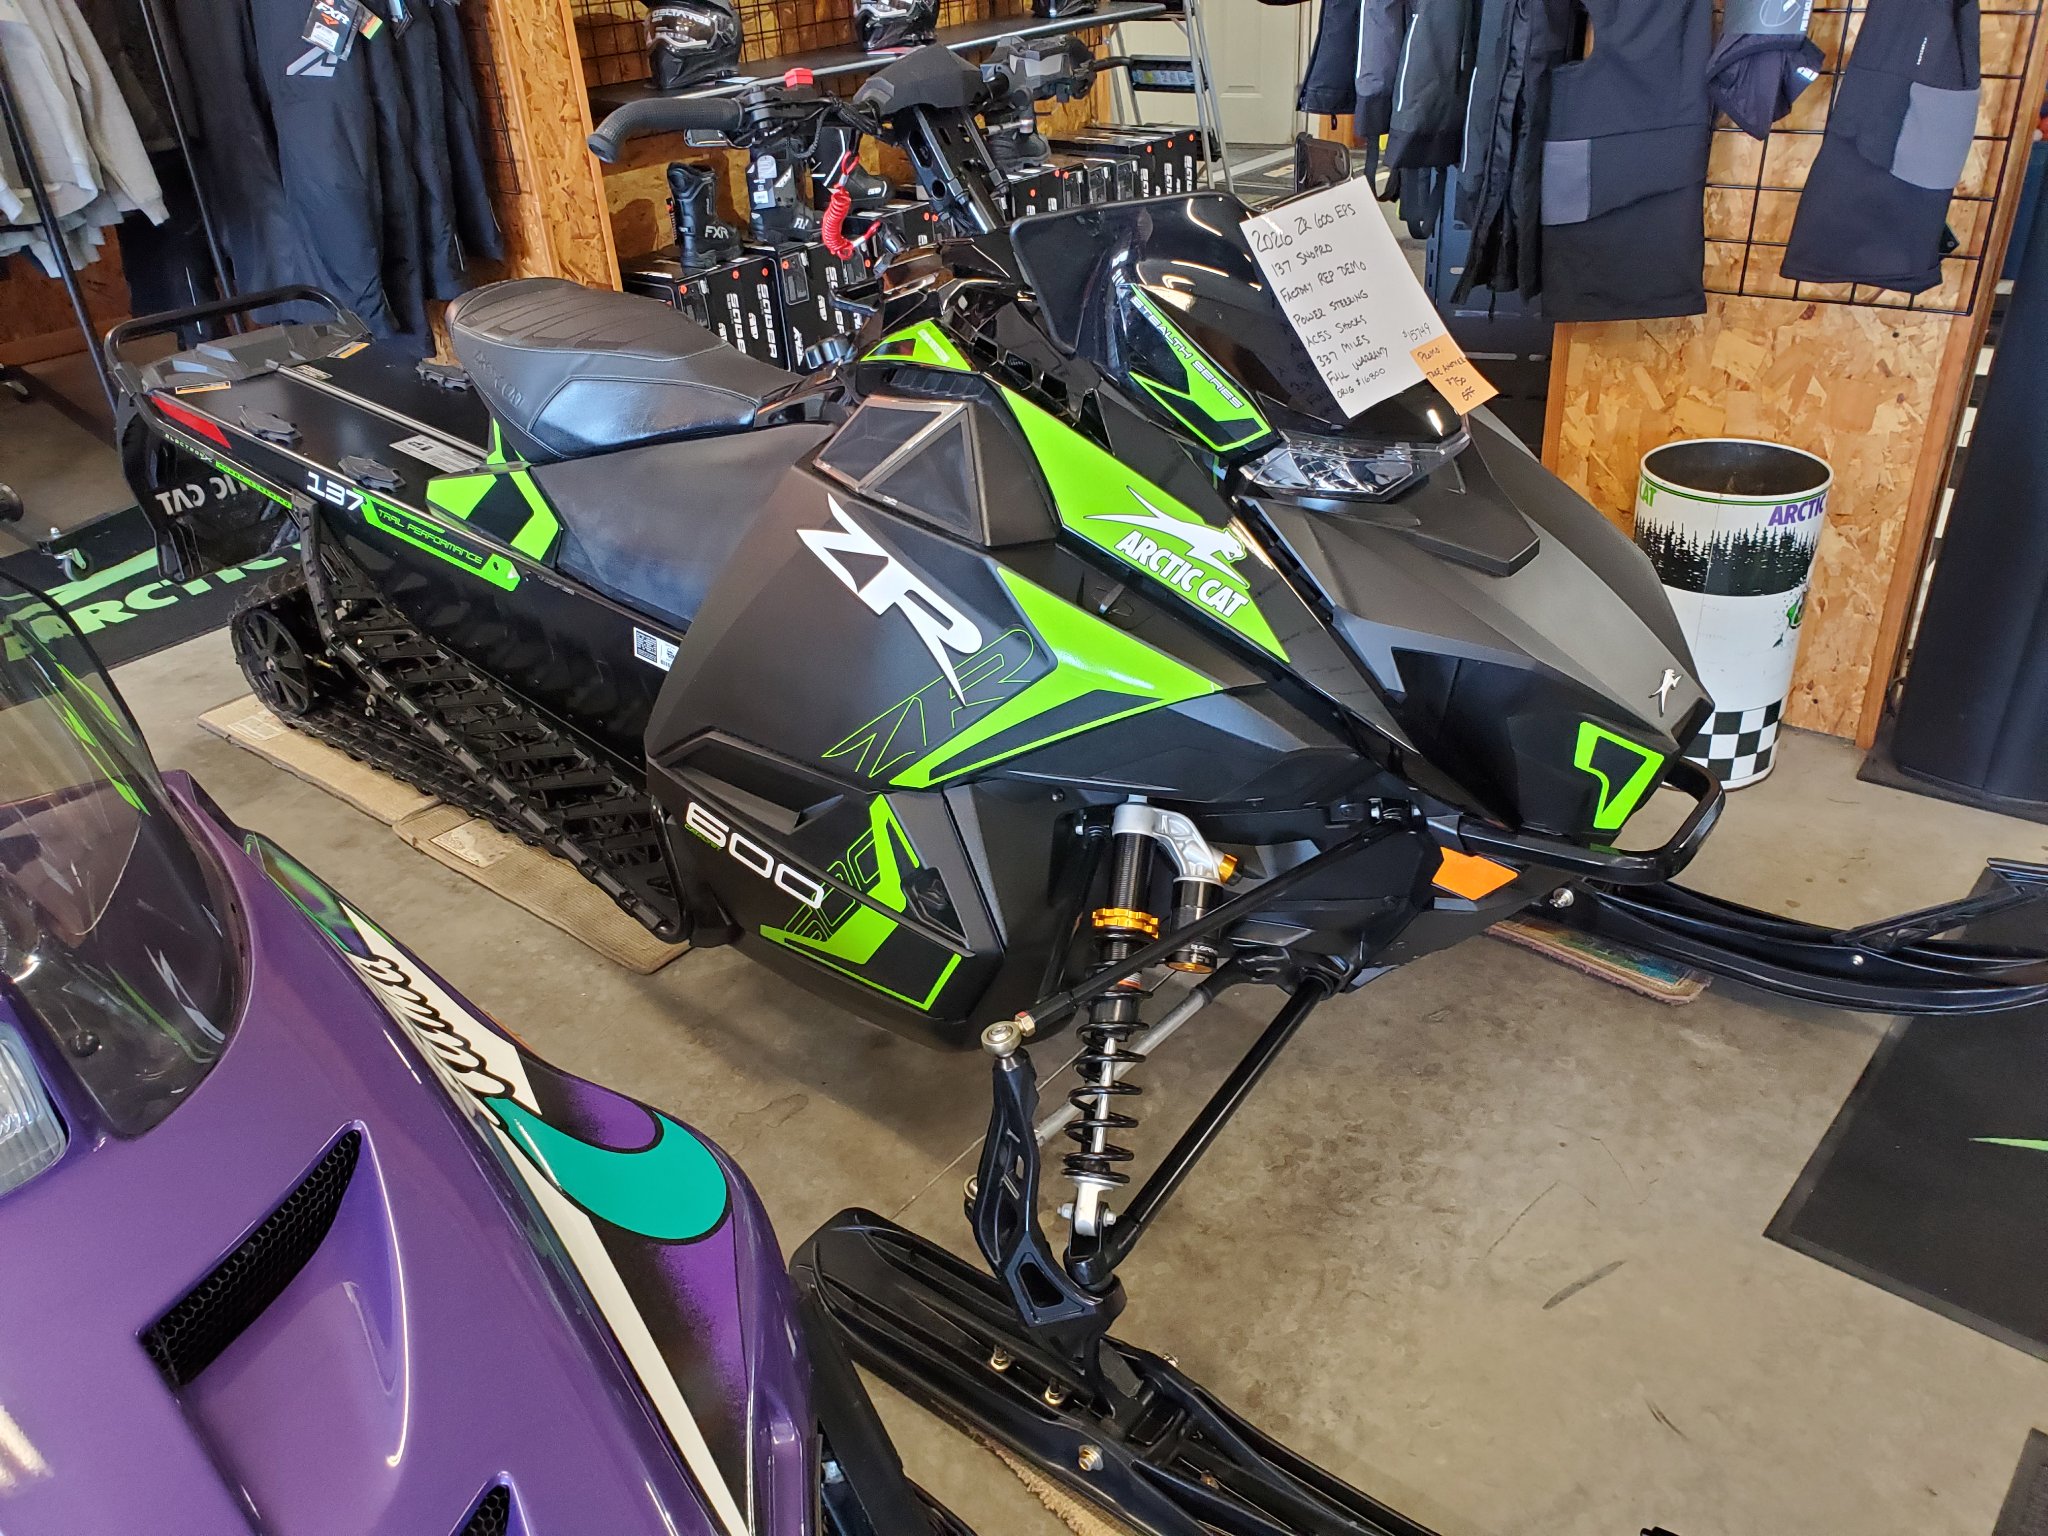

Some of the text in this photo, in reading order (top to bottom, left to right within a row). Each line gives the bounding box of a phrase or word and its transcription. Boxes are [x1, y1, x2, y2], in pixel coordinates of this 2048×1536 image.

[315, 1, 350, 25] FXR
[704, 225, 730, 239] FXR
[1251, 203, 1356, 252] 2026 ZR 600 EPS
[1271, 260, 1292, 277] 137
[1279, 260, 1367, 303] FACTORY REP DEMO
[730, 293, 747, 354] SABE
[760, 283, 778, 359] SABER
[1292, 289, 1369, 327] POWER STEERING
[1335, 314, 1367, 333] SHOCKS
[1130, 296, 1244, 409] STEALTH SERIES
[1316, 334, 1371, 367] 337 MILES
[1326, 346, 1388, 386] FULL WARRANTY
[1337, 368, 1386, 398] ORIG $16800
[306, 471, 484, 565] 137 TRAIL PERFORMANCE
[1114, 529, 1250, 618] ARCTIC CAT
[796, 493, 983, 707] ZR
[685, 801, 825, 909] 600
